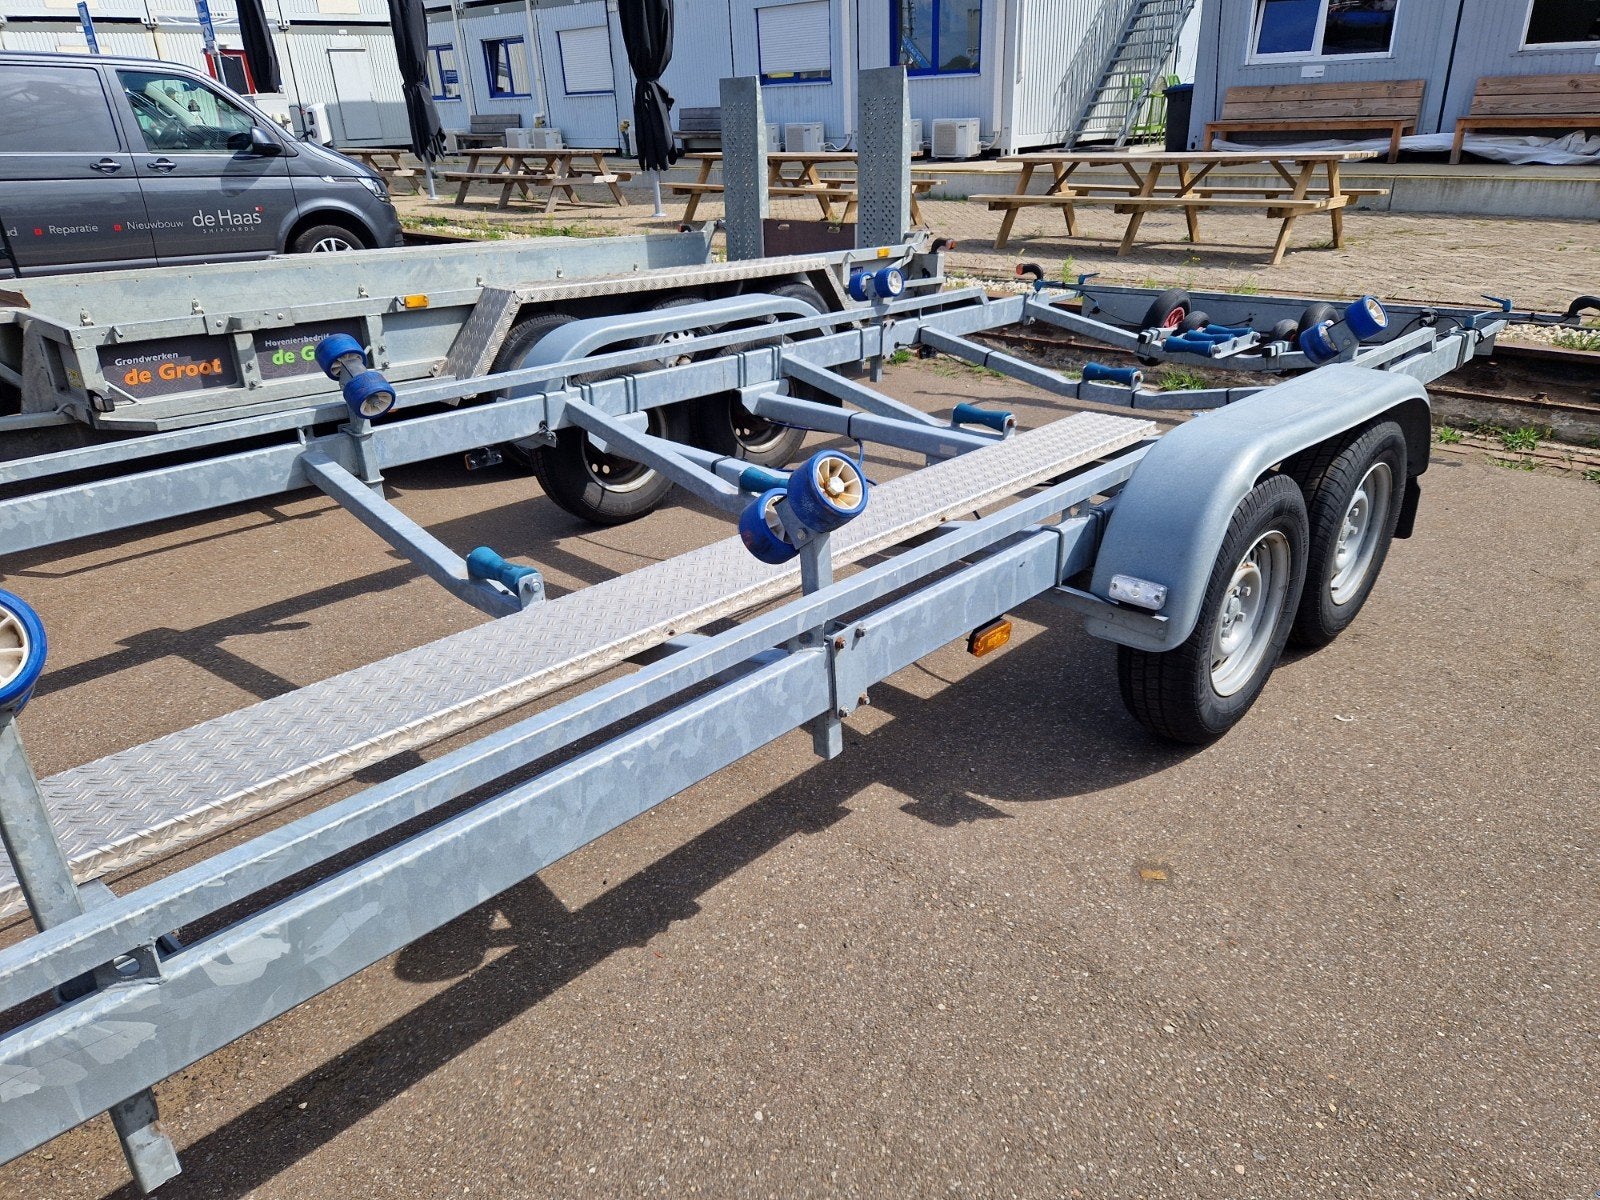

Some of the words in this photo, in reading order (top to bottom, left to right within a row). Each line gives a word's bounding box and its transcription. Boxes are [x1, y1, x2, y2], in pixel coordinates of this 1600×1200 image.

[192, 209, 215, 227] de
[217, 209, 262, 226] Haas
[6, 226, 18, 237] ud
[48, 223, 99, 236] Reparatie
[126, 220, 184, 231] Nieuwbouw
[202, 226, 255, 234] SHIPYARDS
[114, 352, 179, 366] Grondwerken
[272, 349, 295, 365] de
[300, 345, 316, 361] G
[124, 368, 152, 386] de
[158, 357, 223, 380] Groot
